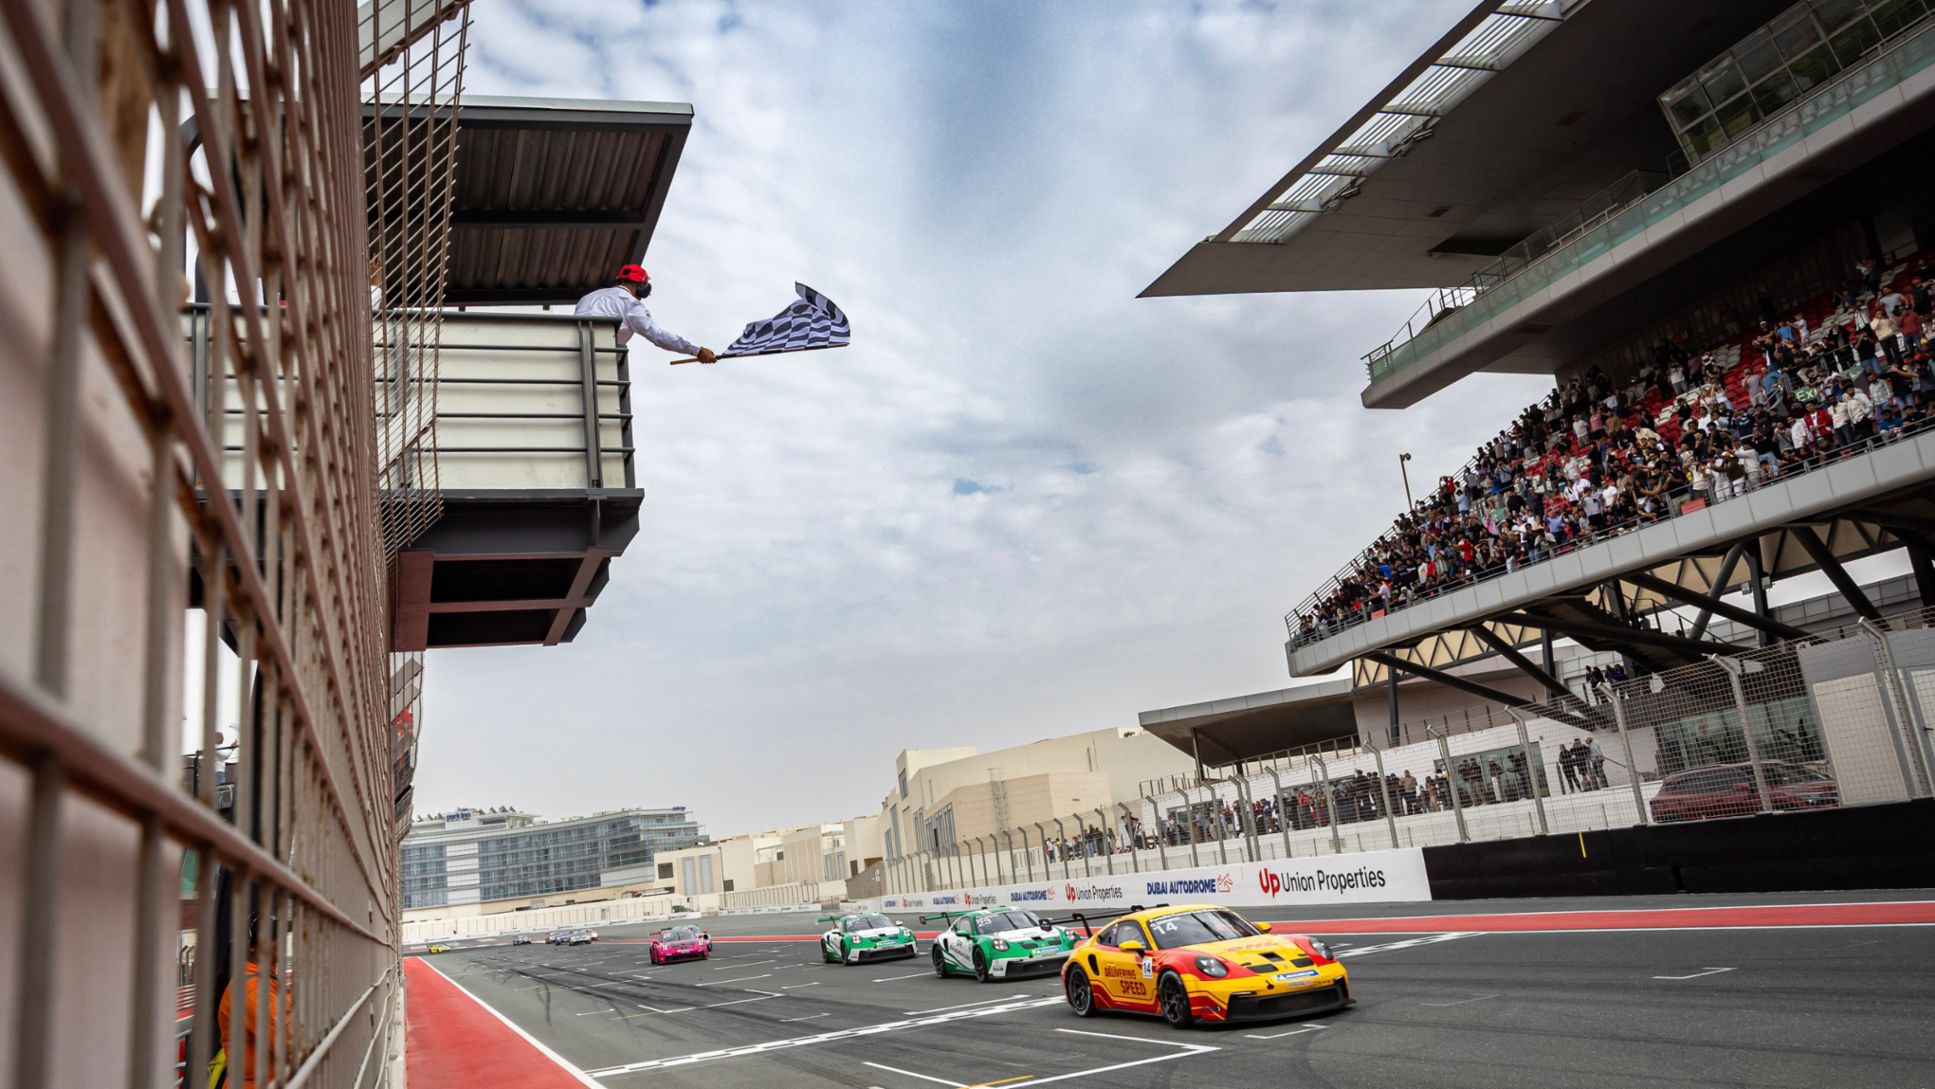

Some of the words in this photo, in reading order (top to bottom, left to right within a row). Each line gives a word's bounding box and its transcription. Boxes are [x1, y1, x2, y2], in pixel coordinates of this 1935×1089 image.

[1796, 387, 1818, 402] EXI
[1147, 882, 1168, 895] DUBAI
[1169, 878, 1216, 894] AUTODROME
[1259, 868, 1280, 898] Up
[1281, 872, 1316, 892] Union
[1317, 866, 1386, 894] Properties
[1076, 885, 1092, 900] Union
[1092, 884, 1122, 902] Properties
[1153, 921, 1178, 935] 14
[1104, 965, 1137, 980] DELIVERING
[1143, 962, 1152, 975] 14
[1120, 979, 1147, 996] SPEED
